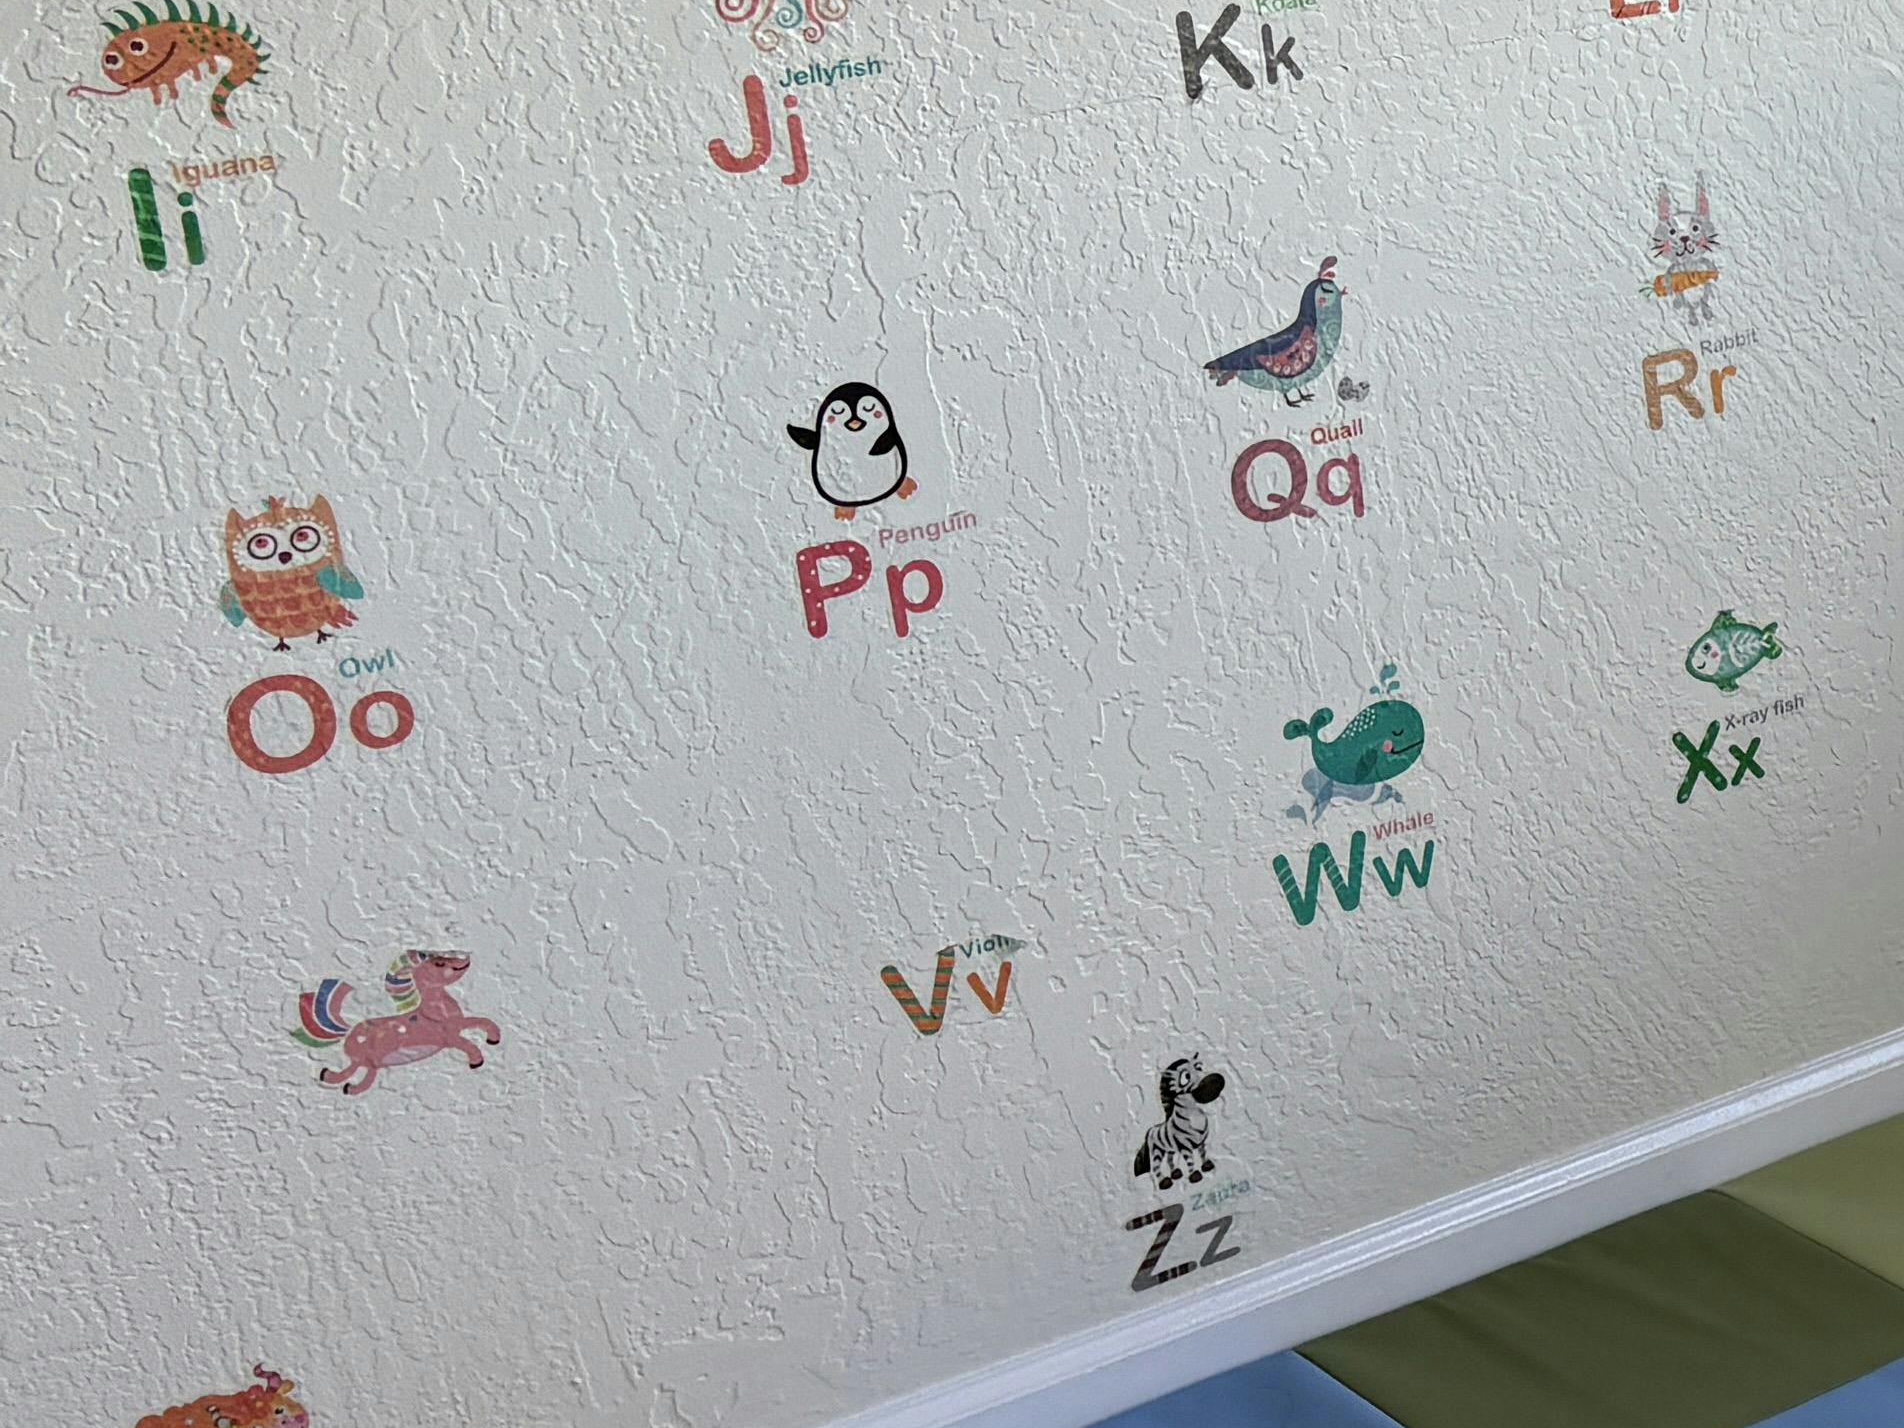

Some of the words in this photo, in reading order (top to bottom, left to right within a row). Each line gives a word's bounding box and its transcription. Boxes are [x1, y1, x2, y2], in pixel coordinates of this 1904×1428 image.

[779, 56, 882, 88] Jellyfish
[1176, 3, 1303, 99] Kk
[172, 153, 276, 187] Iguana
[708, 74, 809, 185] Jj
[128, 167, 205, 271] Ii
[1699, 328, 1759, 356] Rabbit
[1640, 348, 1738, 431] Rr
[1230, 438, 1366, 523] Qq
[878, 509, 978, 549] Penguin
[796, 539, 944, 640] Pp
[338, 648, 396, 679] Owl
[226, 674, 415, 773] Oo
[1724, 704, 1769, 731] X-ray
[1772, 693, 1805, 718] fish
[1672, 719, 1766, 804] Xx
[1372, 809, 1435, 840] Whale
[1272, 830, 1435, 926] Ww
[880, 944, 1012, 1036] Vv
[1125, 1203, 1241, 1292] Zz
